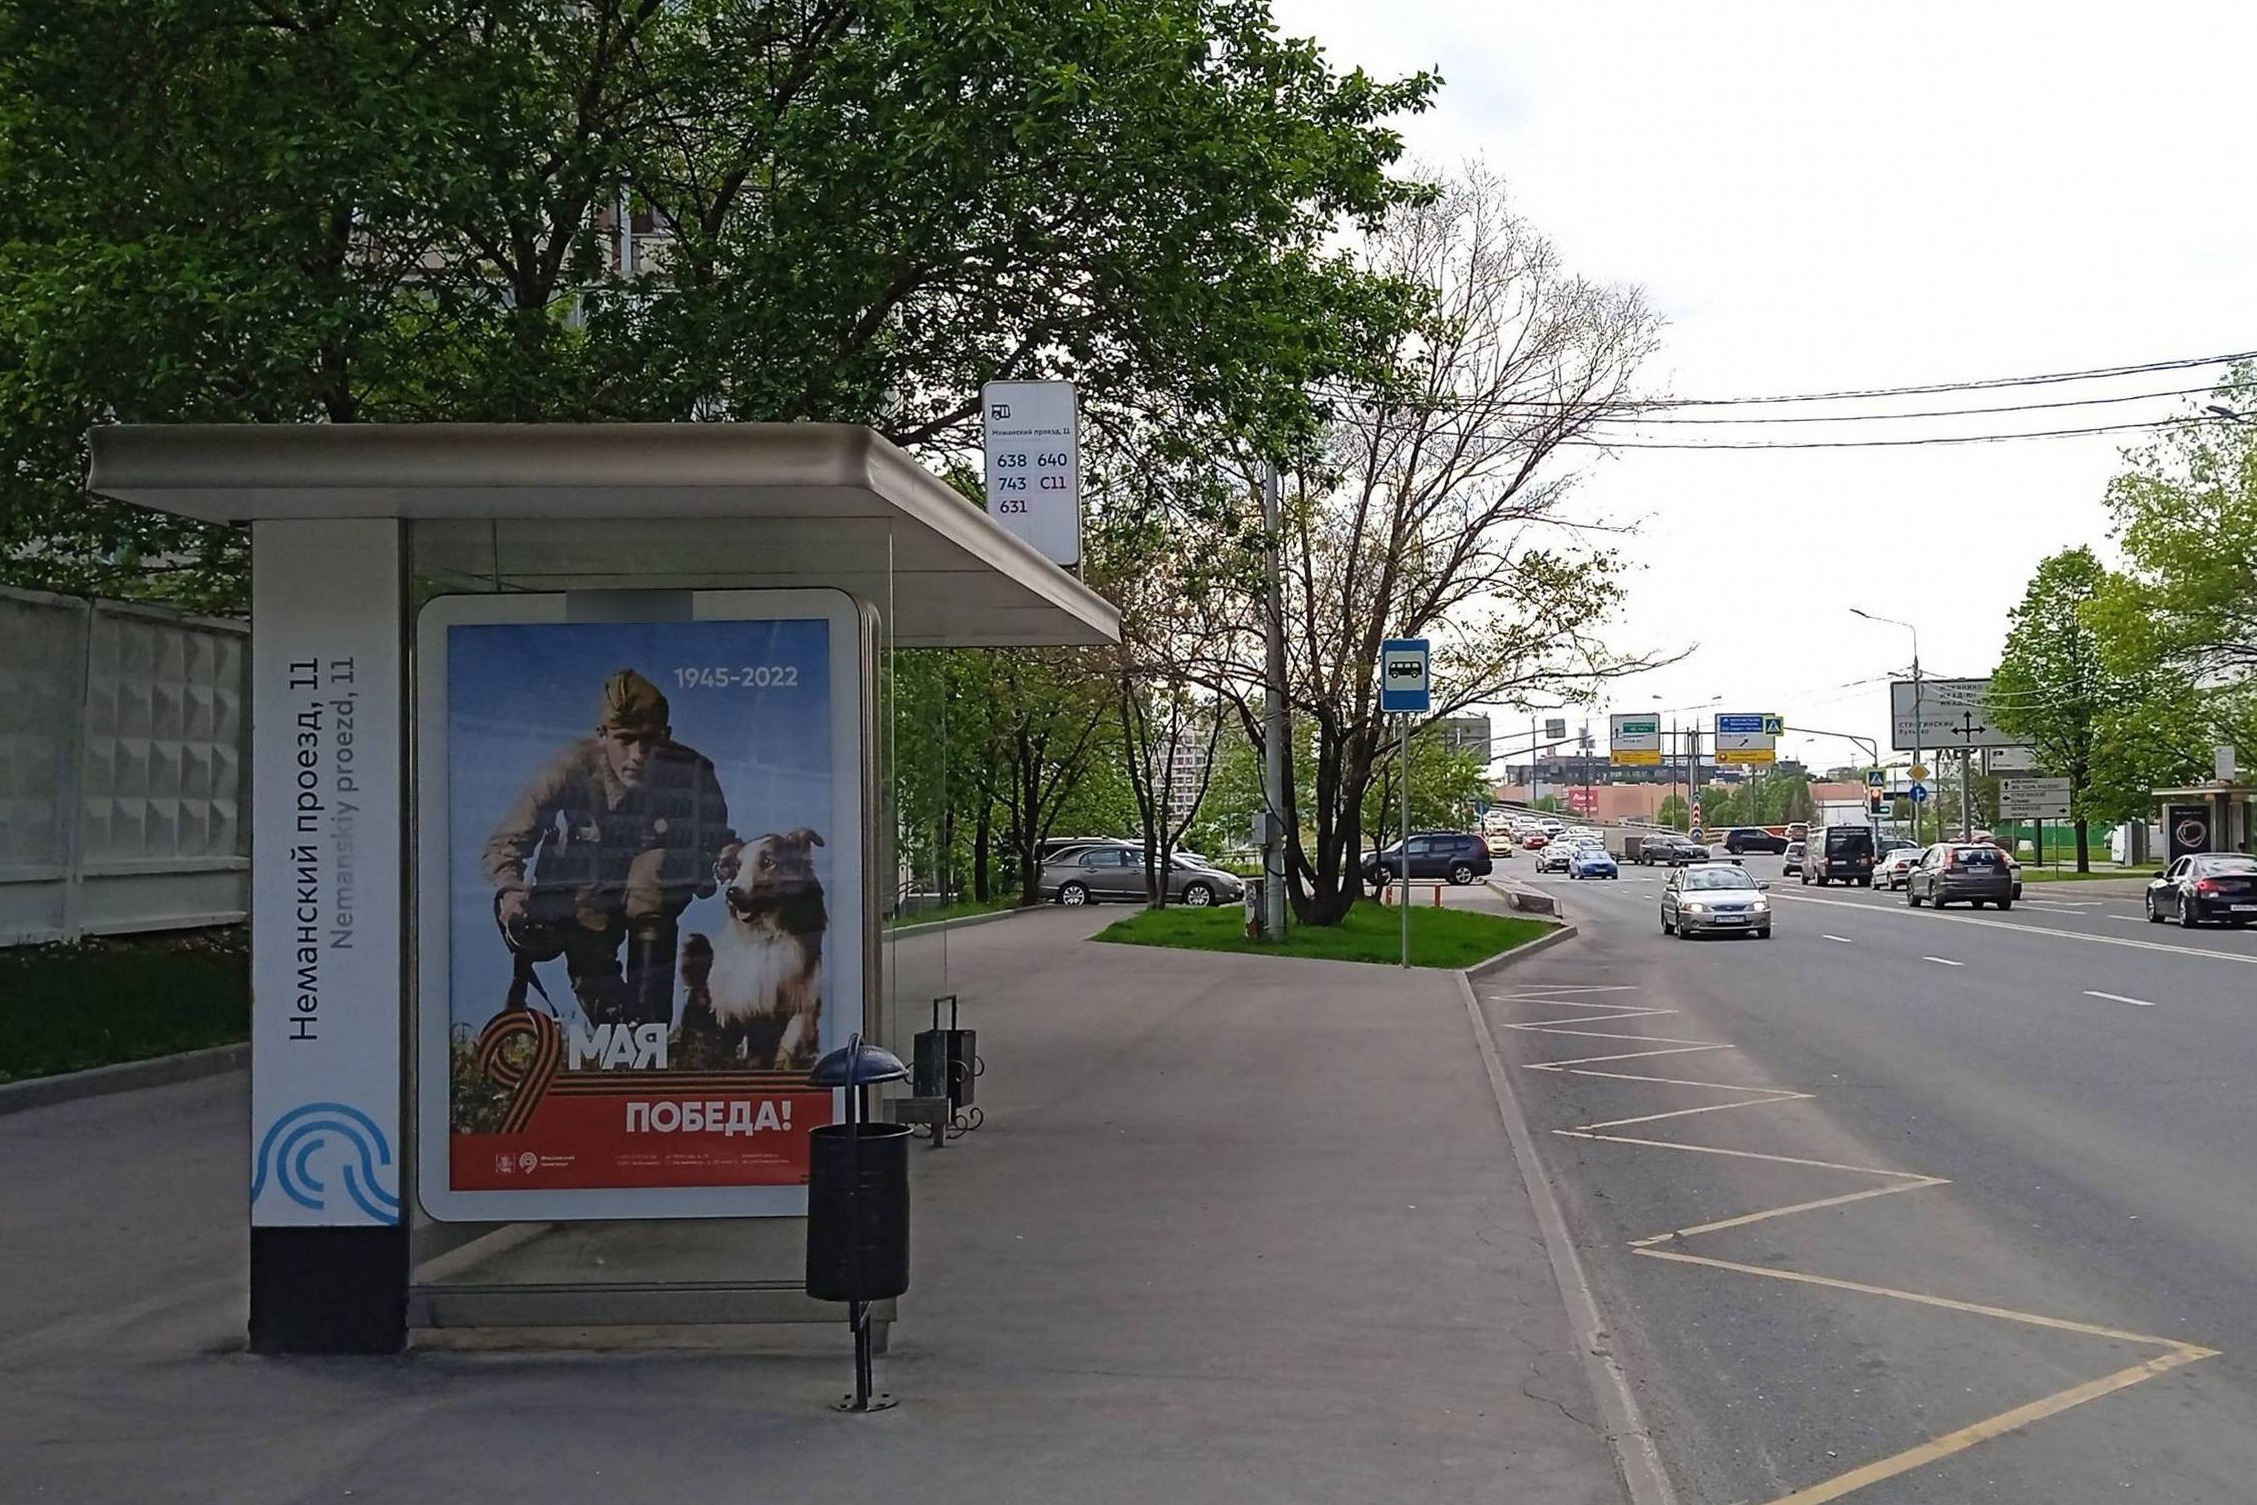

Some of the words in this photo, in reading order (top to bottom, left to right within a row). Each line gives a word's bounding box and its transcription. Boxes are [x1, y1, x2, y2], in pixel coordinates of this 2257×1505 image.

[997, 454, 1027, 468] 638
[1037, 453, 1068, 467] 640
[998, 476, 1027, 490] 743
[1000, 500, 1028, 514] 631
[290, 657, 318, 690] 11
[330, 657, 354, 684] 11
[674, 666, 799, 689] 1945-2022
[1898, 720, 1955, 728] СТРГИНСКИЙ
[330, 690, 359, 792] proezd,
[297, 701, 325, 832] проезд,
[330, 800, 360, 949] Nemanskiy
[289, 845, 318, 1041] Неманский
[568, 1022, 669, 1071] МАЯ
[625, 1100, 792, 1137] ПОБЕДА!
